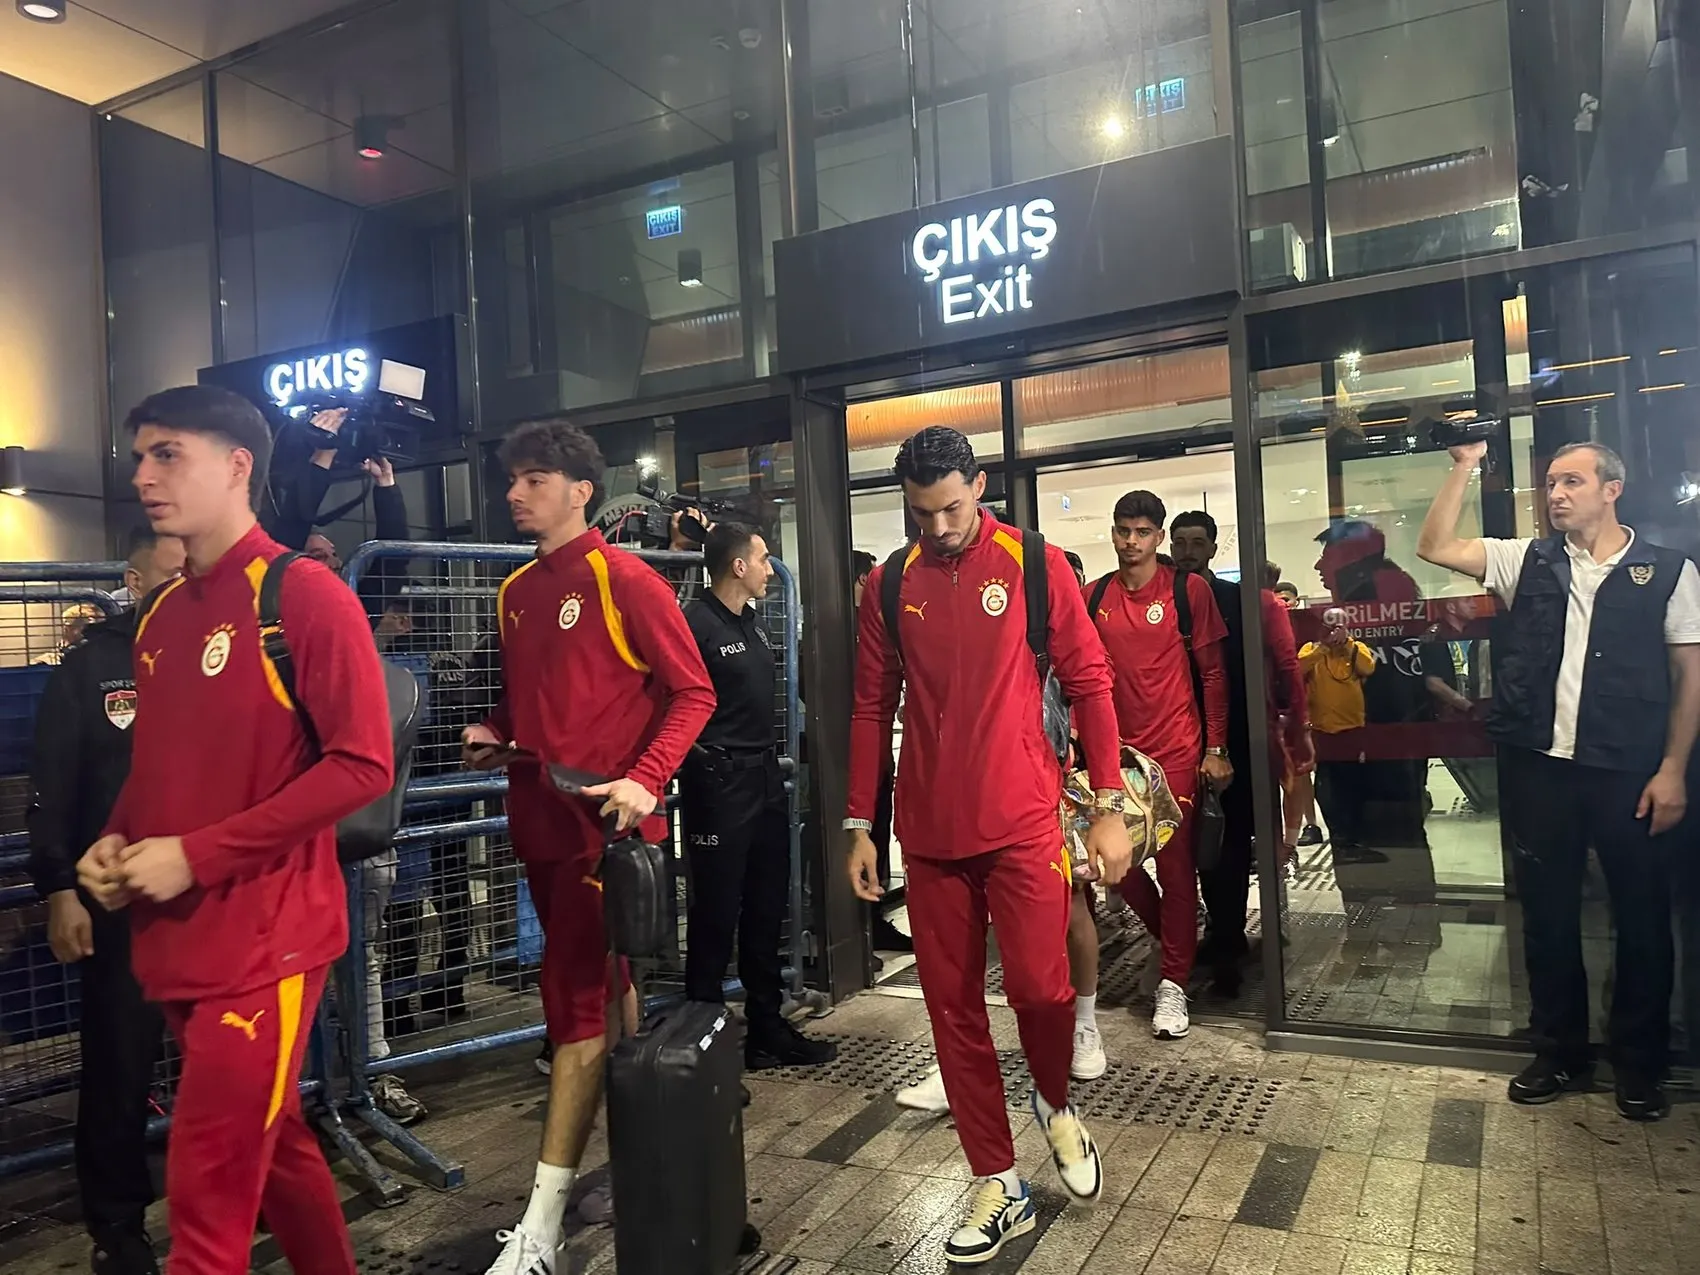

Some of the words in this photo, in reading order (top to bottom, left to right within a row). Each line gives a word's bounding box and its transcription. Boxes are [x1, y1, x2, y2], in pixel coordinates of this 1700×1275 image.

[912, 198, 1058, 283] ÇIKIŞ
[941, 263, 1034, 324] Exit
[269, 347, 368, 408] ÇIKIŞ
[1345, 628, 1361, 639] NO
[1365, 625, 1404, 638] ENTRY
